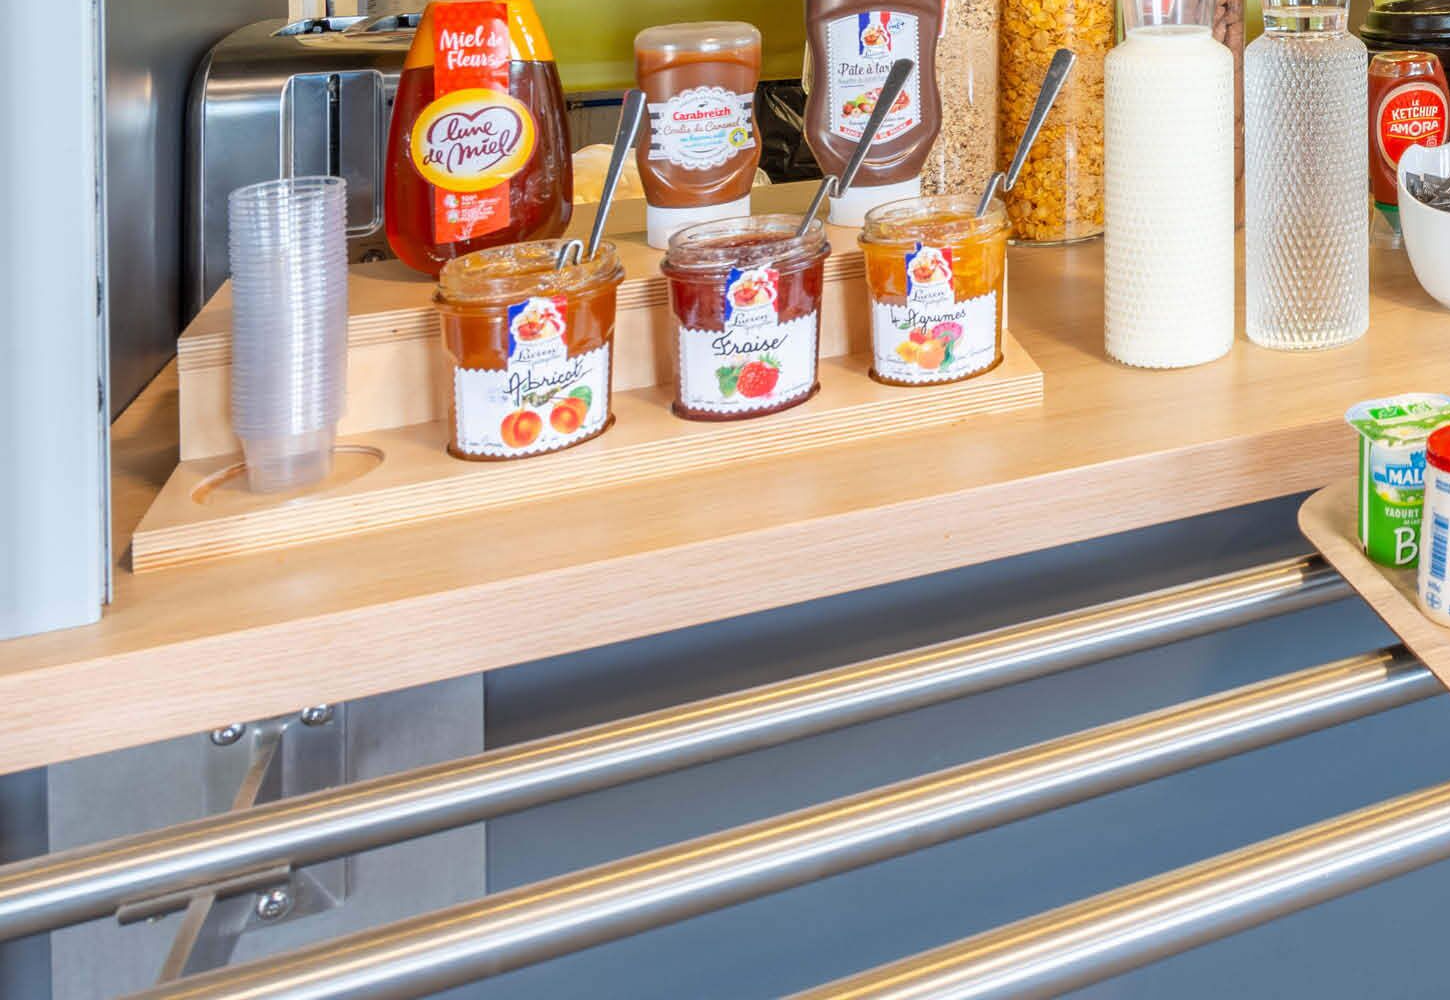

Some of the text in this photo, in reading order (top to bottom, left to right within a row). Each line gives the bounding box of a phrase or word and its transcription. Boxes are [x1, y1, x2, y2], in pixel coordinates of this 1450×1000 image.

[440, 25, 485, 51] Miel
[447, 49, 497, 70] Fleurs
[672, 106, 732, 121] Carabreizh
[1391, 105, 1439, 121] KETCHUP
[1411, 99, 1420, 107] LE
[440, 117, 498, 142] lune
[1389, 119, 1439, 137] AMORA
[423, 129, 511, 174] de miel
[889, 307, 967, 335] 4 Agrumes
[711, 330, 789, 356] Fraise
[503, 358, 587, 407] Abricot
[1387, 468, 1424, 485] MAL
[1384, 506, 1420, 518] YAOURT
[1393, 526, 1419, 566] B
